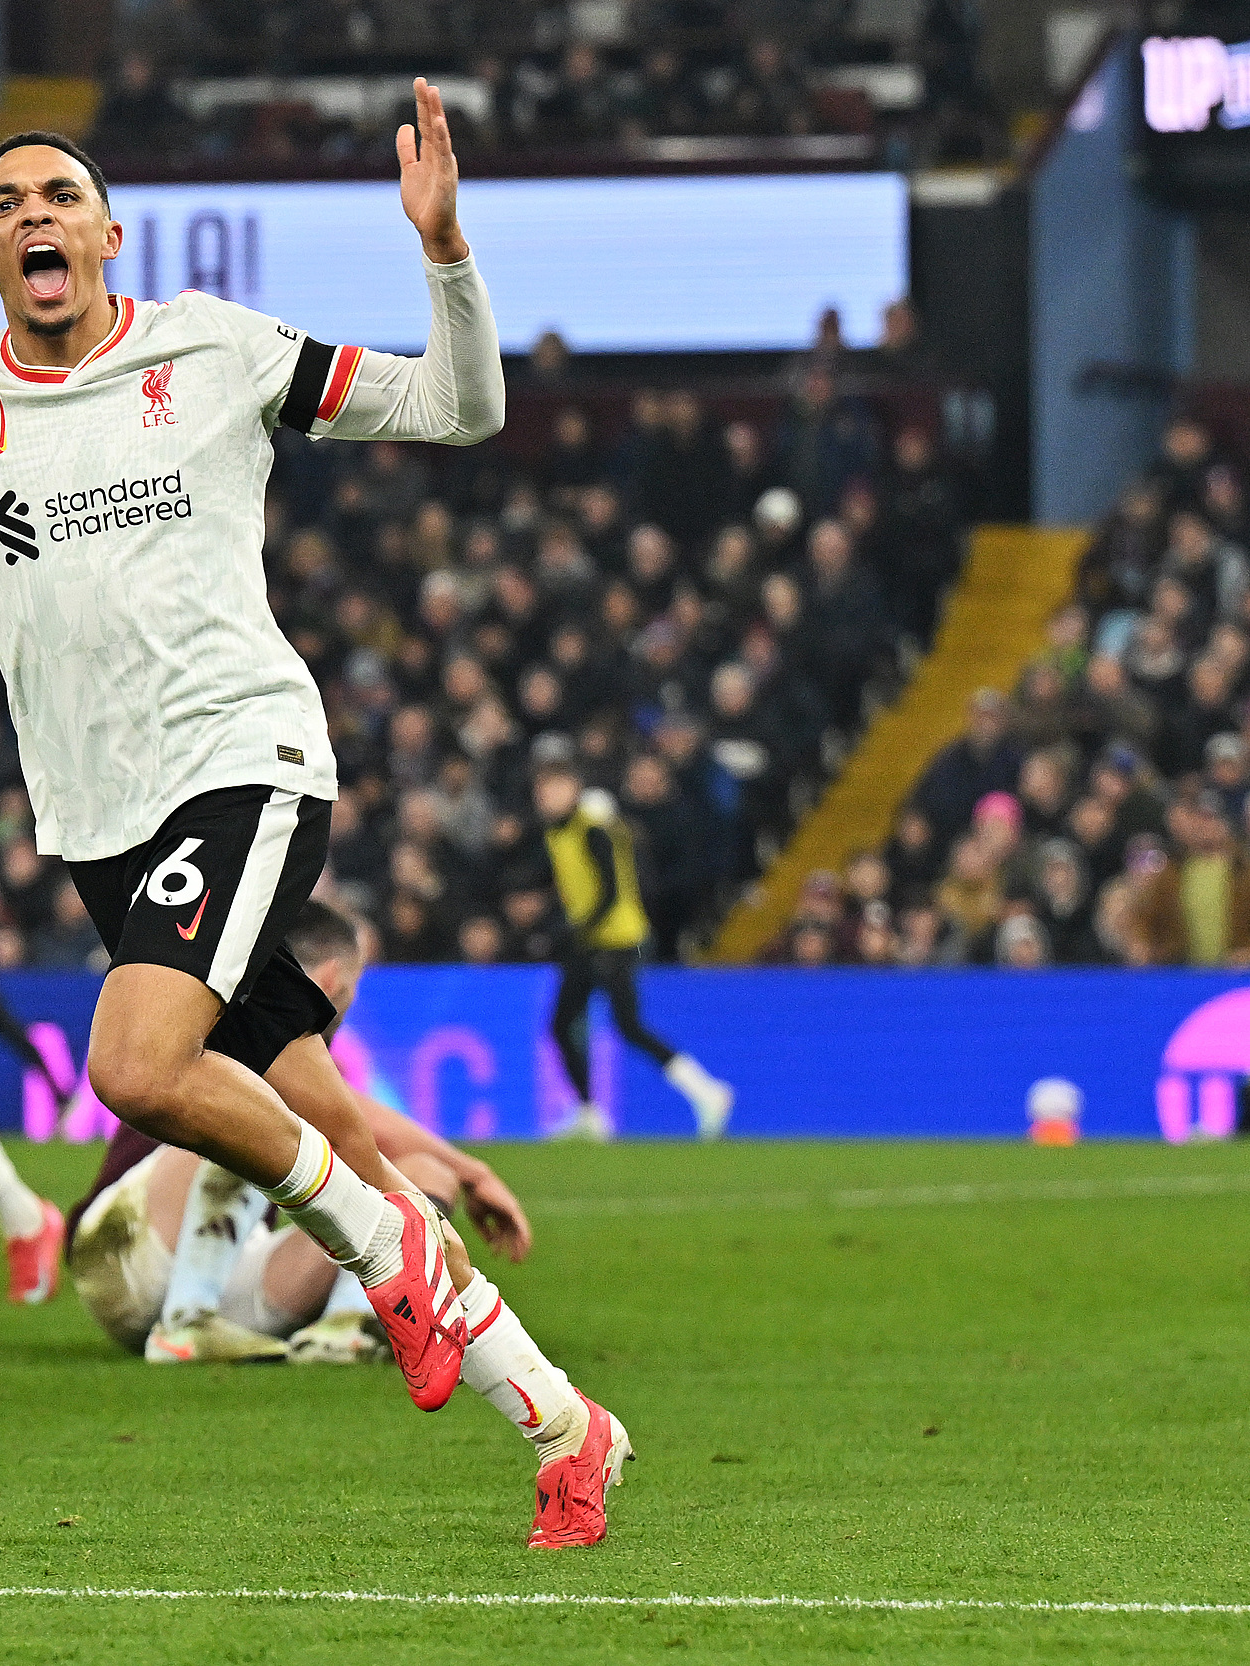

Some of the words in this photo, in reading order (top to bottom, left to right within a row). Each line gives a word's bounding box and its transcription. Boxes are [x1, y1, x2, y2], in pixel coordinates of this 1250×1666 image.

[143, 412, 179, 428] L.F.C.
[44, 469, 182, 518] standard
[50, 494, 192, 542] chartered
[129, 837, 205, 906] 6
